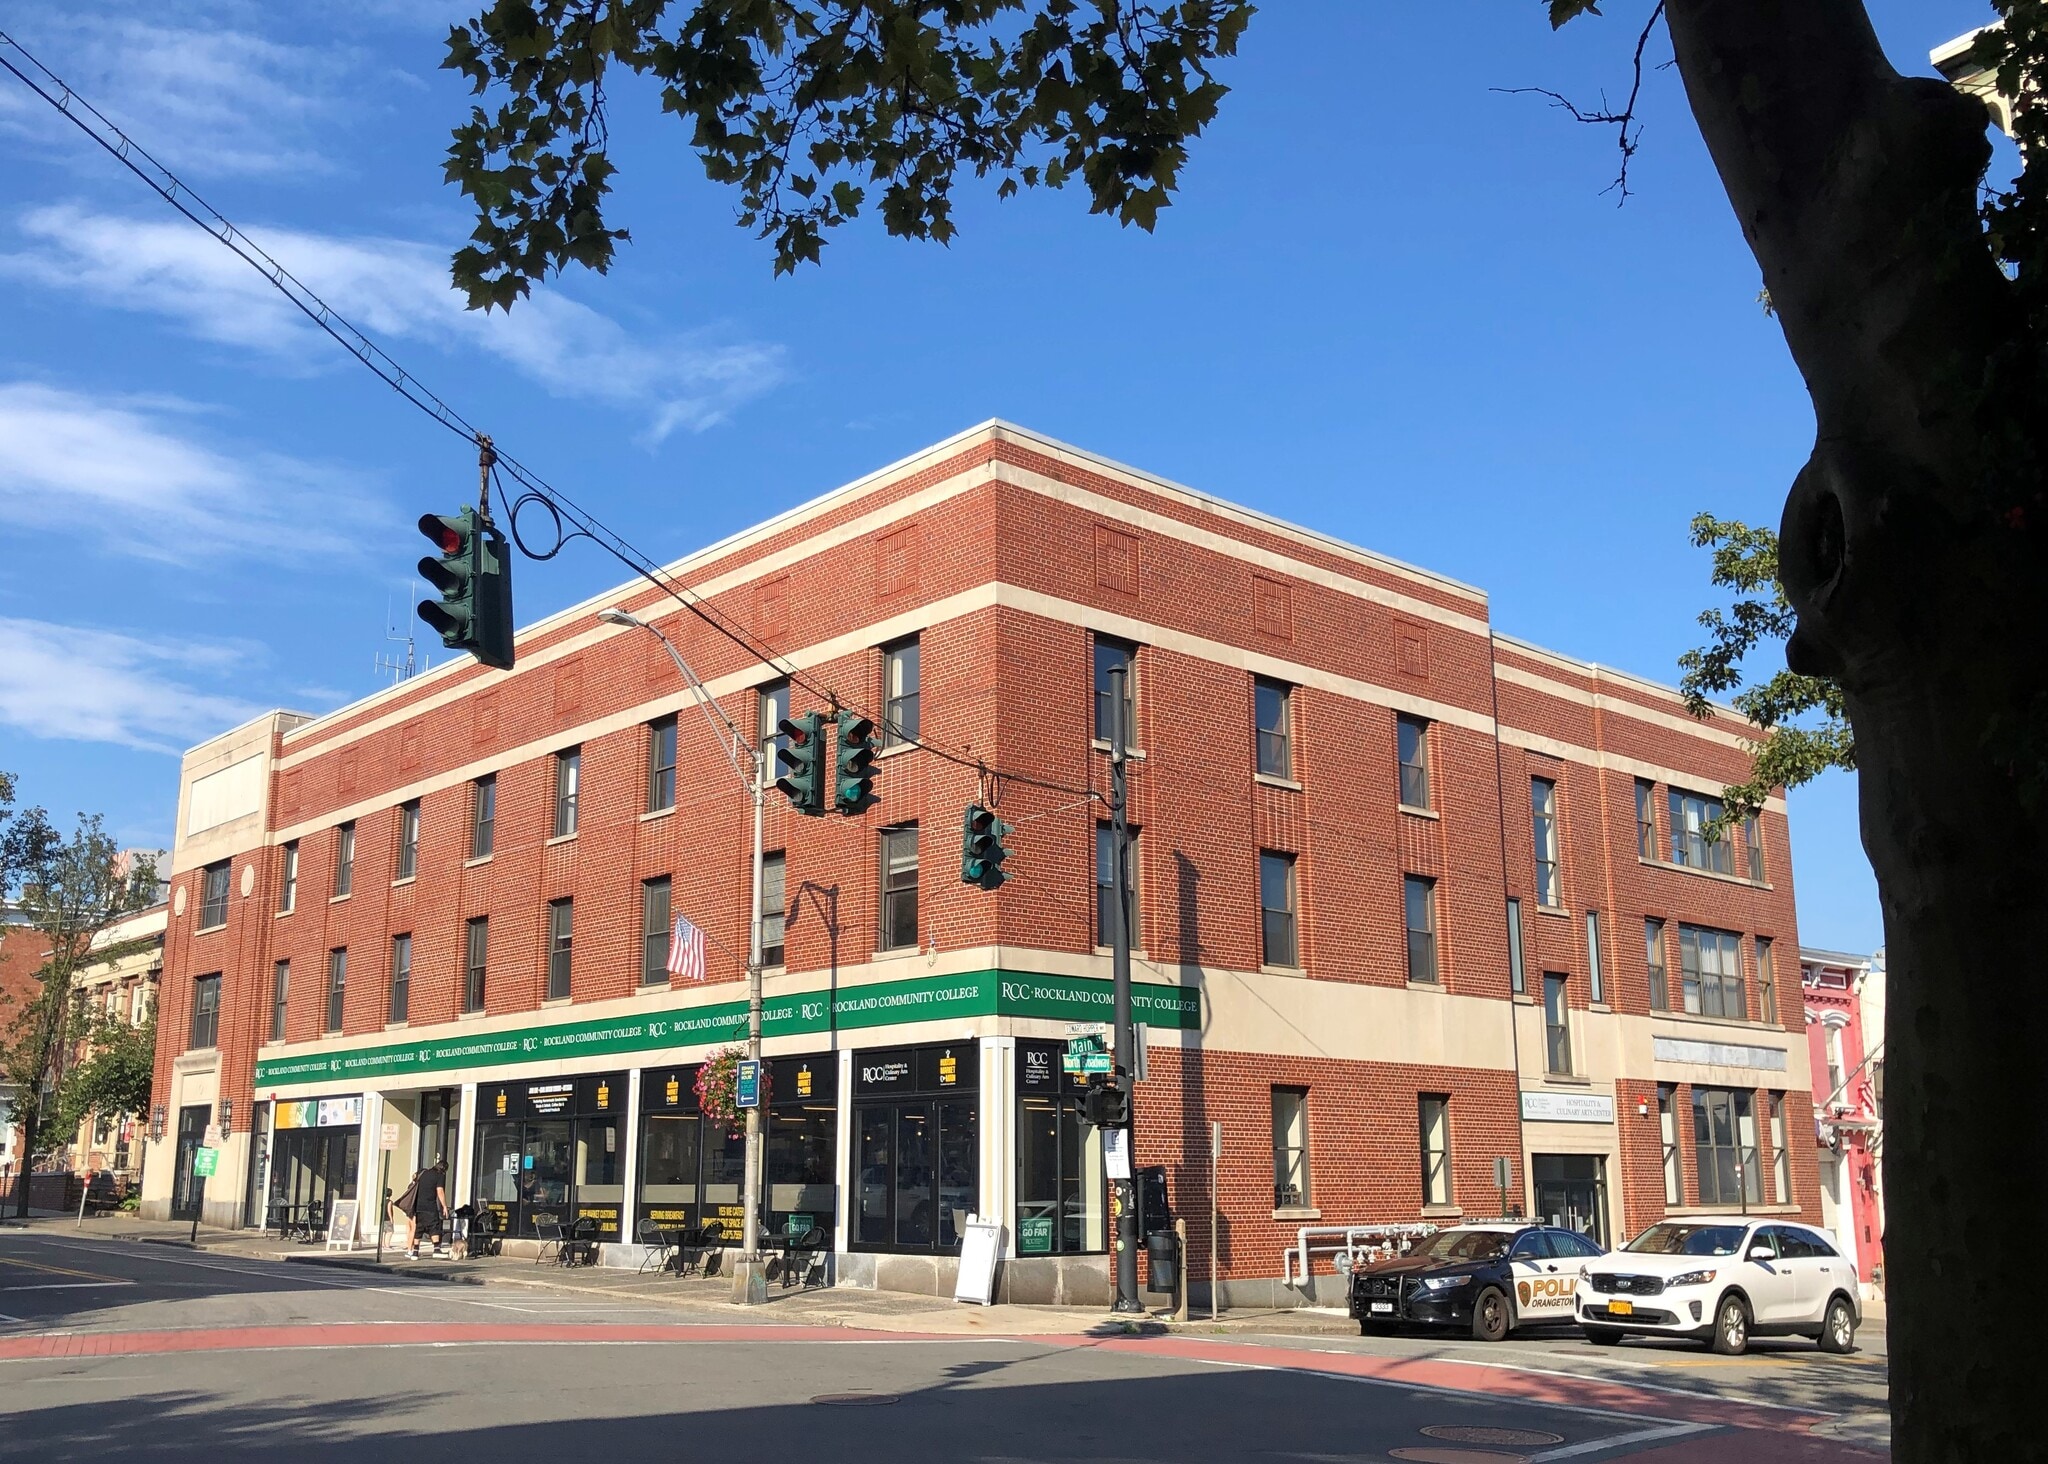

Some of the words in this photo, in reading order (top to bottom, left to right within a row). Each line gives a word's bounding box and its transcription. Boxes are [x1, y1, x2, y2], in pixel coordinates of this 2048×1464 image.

[1001, 982, 1030, 1001] RCC
[1034, 987, 1091, 1003] ROCKLAND
[1091, 992, 1153, 1008] COMNITY
[1154, 998, 1198, 1012] COLLEGE
[330, 1059, 342, 1072] RCC
[344, 1057, 368, 1068] ROCKLAND
[368, 1055, 393, 1066] COMMUNITY
[393, 1052, 415, 1063] COLLEGE
[418, 1049, 431, 1063] RCC
[435, 1047, 462, 1058] ROCKLAND
[462, 1044, 494, 1055] COMMUNITY
[494, 1041, 518, 1052] COLLEGE
[523, 1037, 538, 1052] RCC
[543, 1034, 576, 1047] ROCKLAND
[575, 1029, 613, 1043] COMMUNITY
[613, 1026, 642, 1039] COLLEGE
[648, 1021, 667, 1038] RCC
[674, 1017, 712, 1032] ROCKLAND
[712, 1013, 750, 1027] COMMUNI
[801, 1002, 823, 1020] RCC
[832, 997, 878, 1013] ROCKLAND
[878, 991, 934, 1007] COMMUNITY
[935, 986, 979, 1001] COLLEGE
[1070, 1039, 1094, 1055] Main
[1027, 1051, 1048, 1066] RCC
[1063, 1055, 1081, 1069] North
[1081, 1055, 1110, 1071] Broadway
[862, 1066, 884, 1083] RCC
[1566, 1098, 1595, 1108] HOSPITALITY
[1556, 1107, 1580, 1116] CULINARY
[1581, 1109, 1593, 1117] ARTS
[1592, 1109, 1612, 1118] CENTER
[1022, 1228, 1033, 1237] GO
[1034, 1228, 1048, 1237] FAR
[1533, 1278, 1578, 1298] POLI
